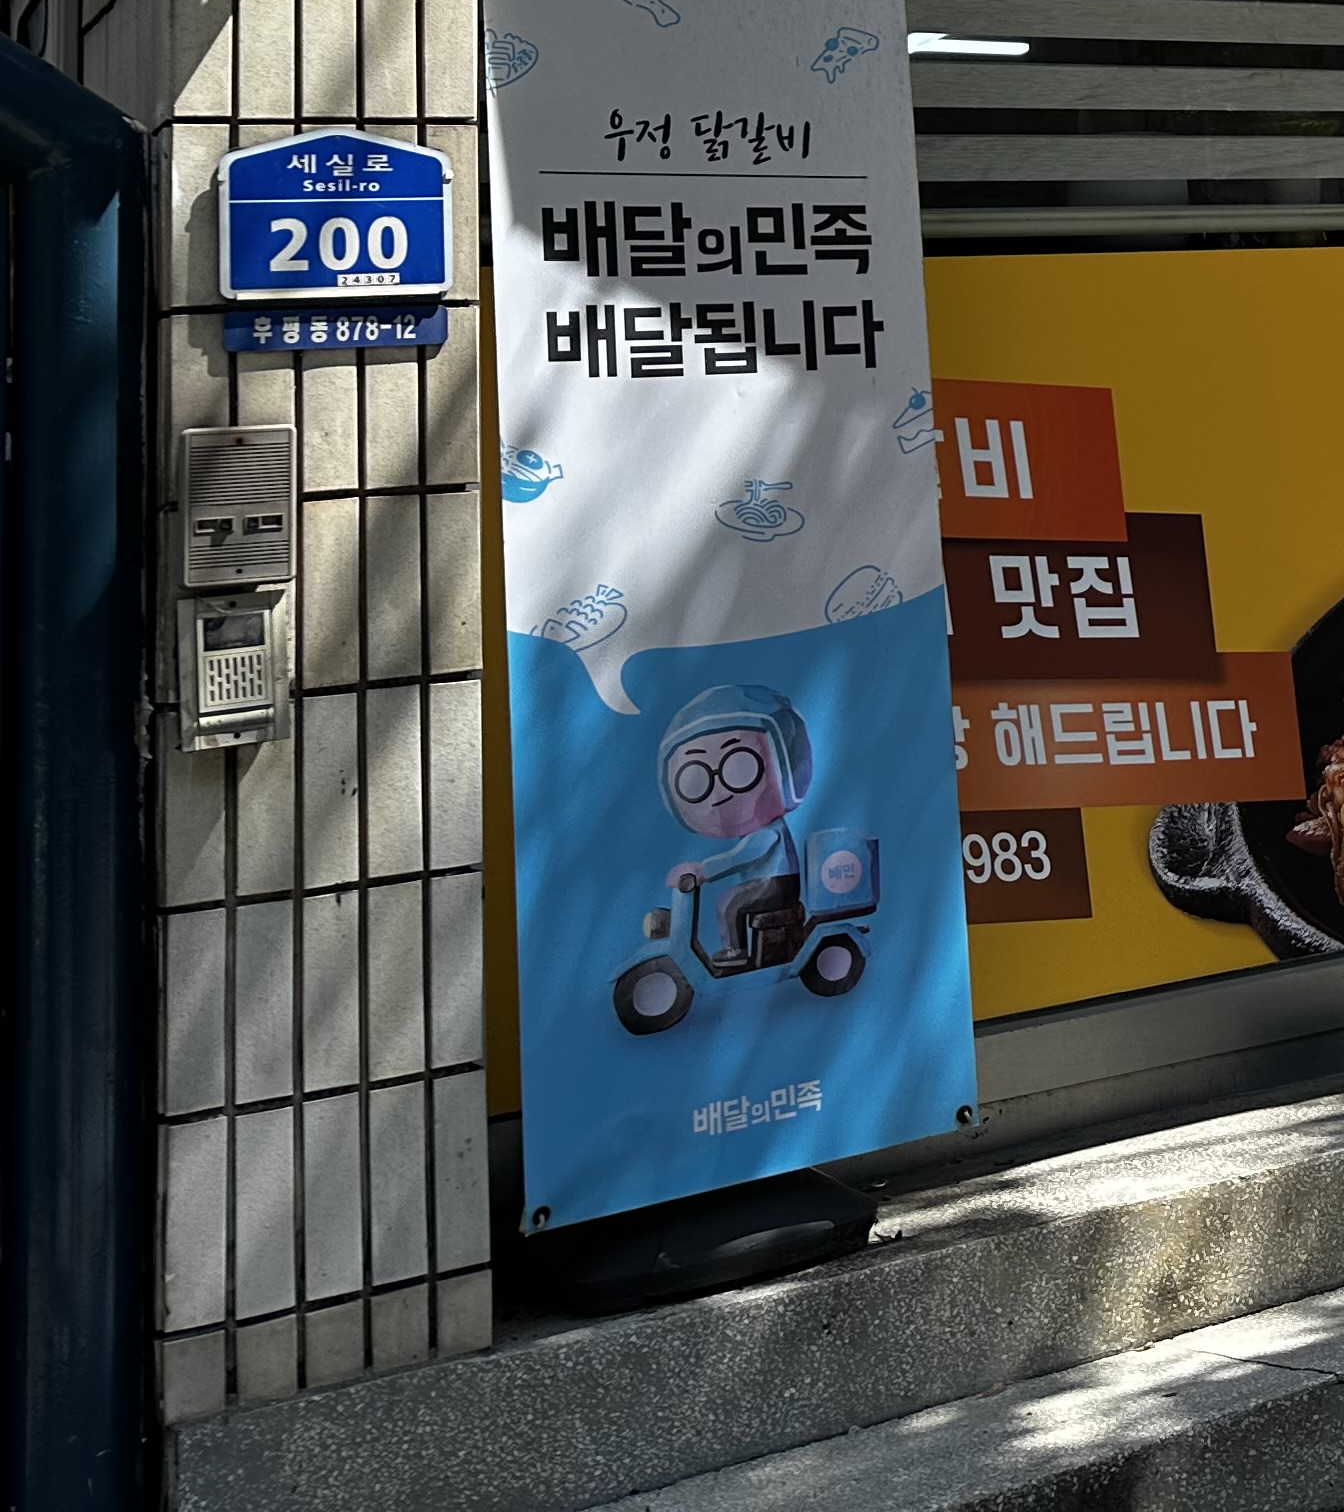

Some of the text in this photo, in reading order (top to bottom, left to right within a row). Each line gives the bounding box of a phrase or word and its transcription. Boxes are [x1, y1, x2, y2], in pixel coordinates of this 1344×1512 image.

[604, 108, 810, 165] 우정 닭갈비
[287, 154, 394, 177] 세실로
[303, 180, 380, 192] Sesil-ro
[269, 216, 408, 272] 200
[540, 200, 872, 278] 배달의민족
[253, 314, 417, 344] 후평동 878-12
[546, 300, 884, 378] 배달됩니다
[934, 418, 1033, 500] 비
[989, 555, 1140, 639] 맛집
[991, 700, 1258, 766] 해드립니다
[693, 1079, 823, 1135] 배달의민족
